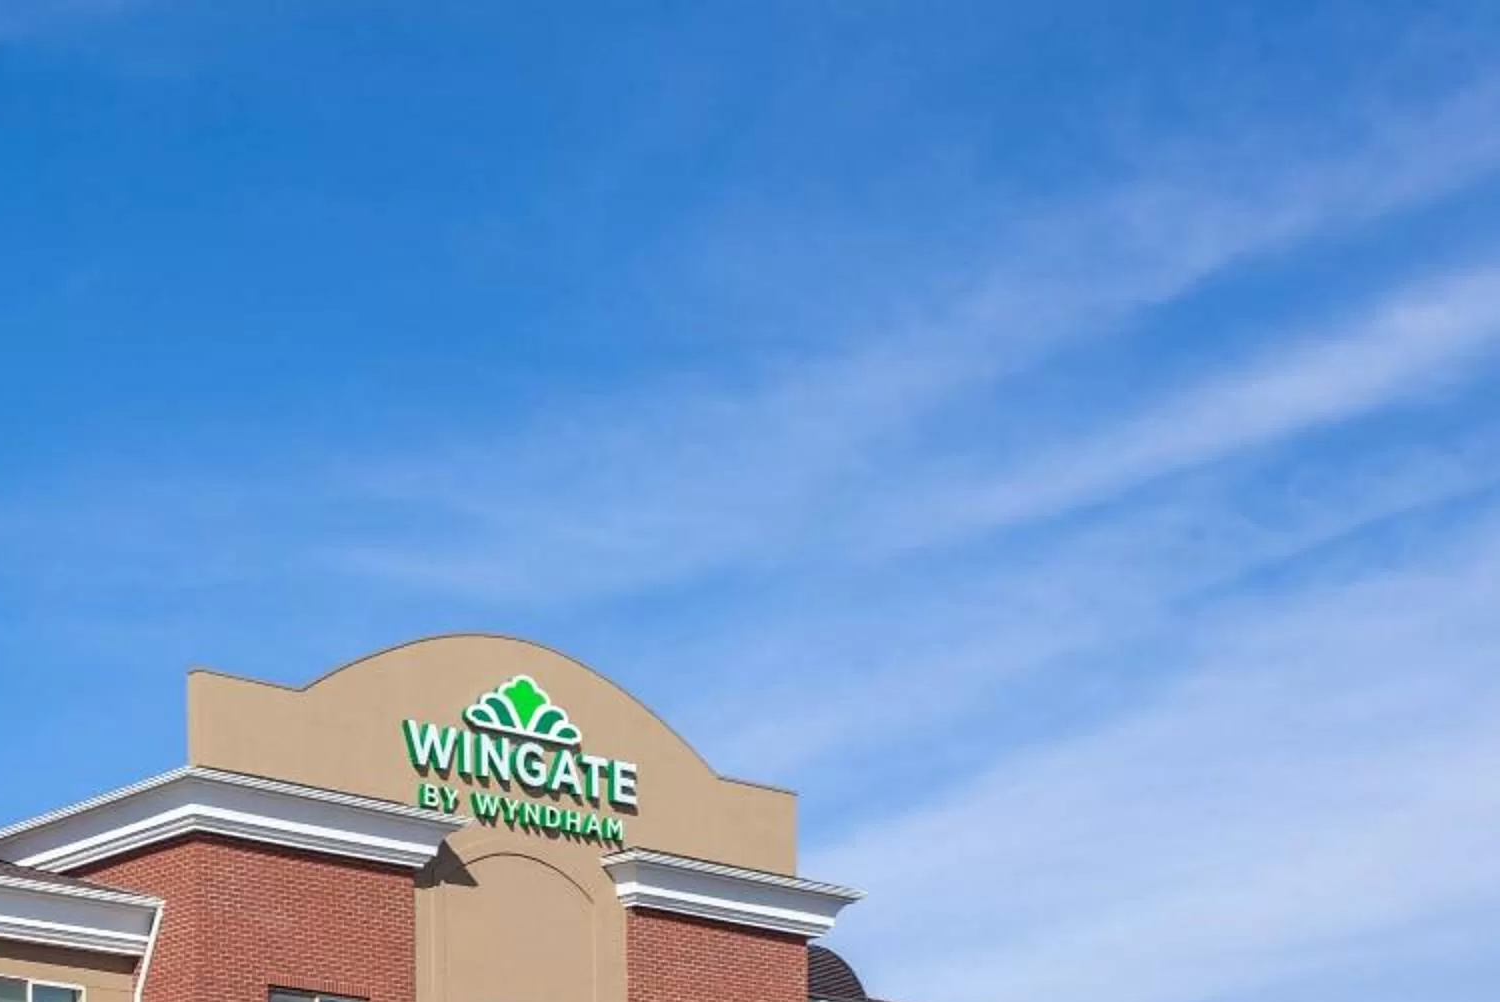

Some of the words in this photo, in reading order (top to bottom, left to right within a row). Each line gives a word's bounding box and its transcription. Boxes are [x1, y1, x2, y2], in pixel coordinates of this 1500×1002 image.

[403, 719, 638, 806] WINGATE
[419, 784, 459, 813] BY
[471, 792, 625, 842] WYNDHAM
